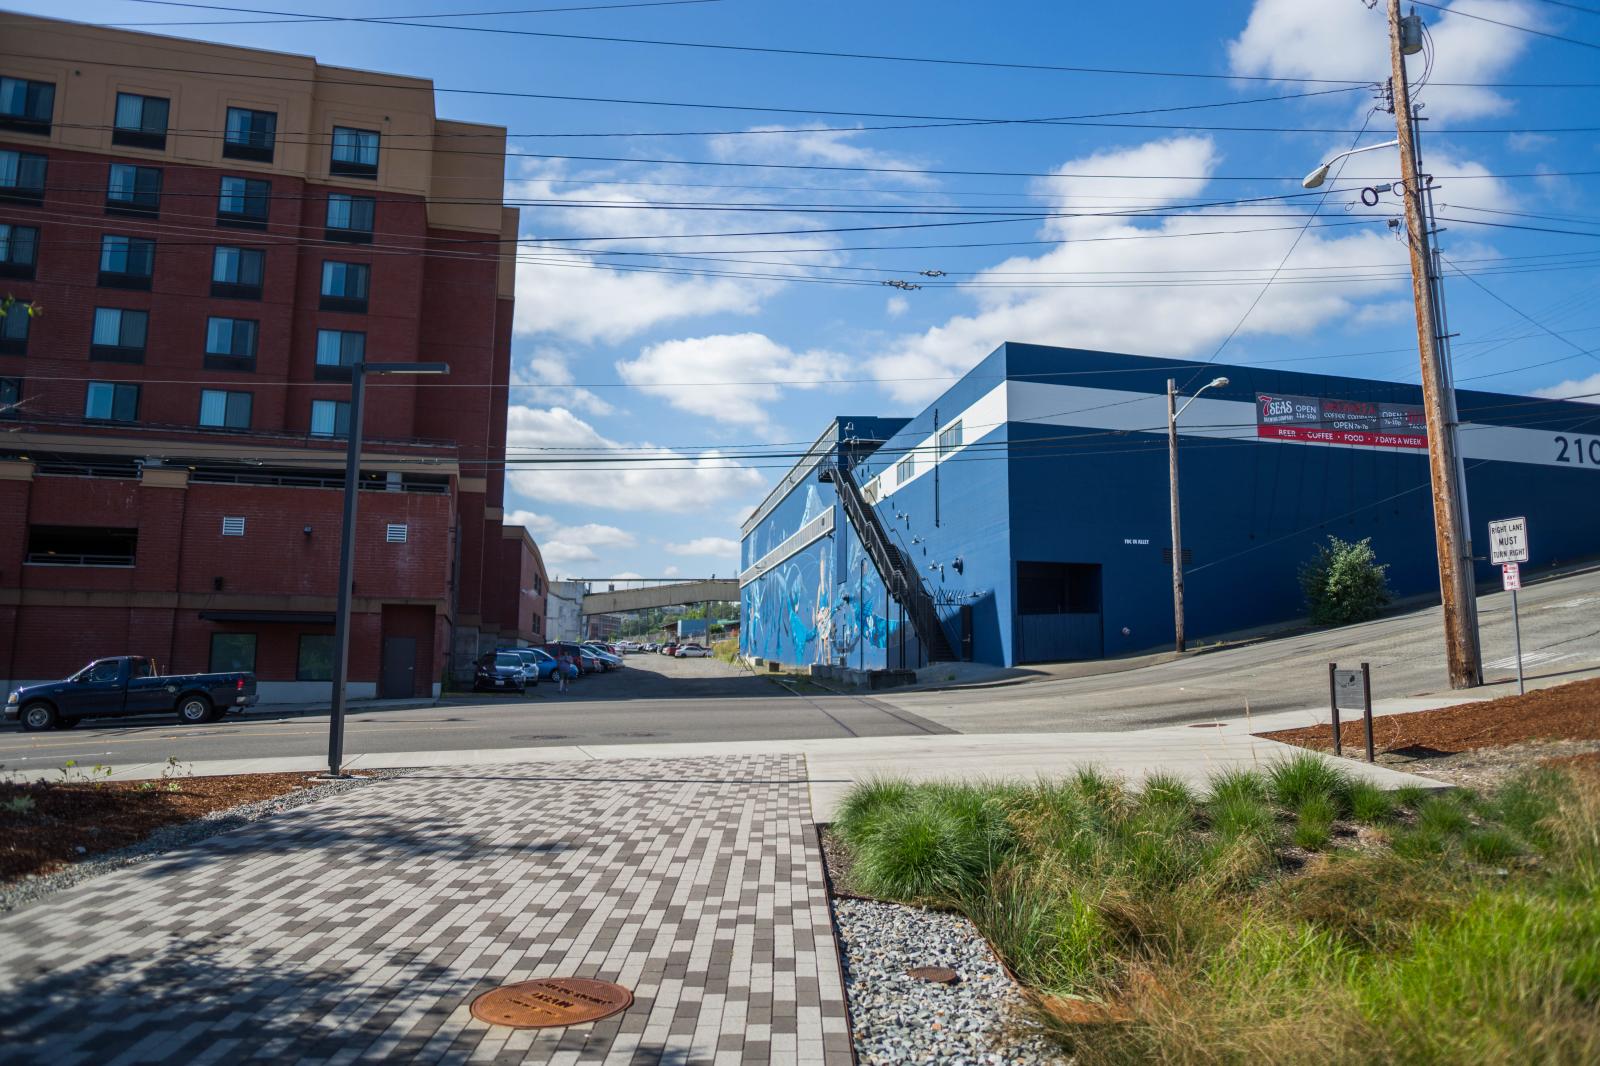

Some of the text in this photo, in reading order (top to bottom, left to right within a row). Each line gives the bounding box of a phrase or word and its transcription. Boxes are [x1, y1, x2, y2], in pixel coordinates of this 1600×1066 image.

[1258, 395, 1293, 416] 7 SEAS
[1295, 405, 1317, 413] OPEN
[1333, 421, 1354, 429] OPEN
[1306, 431, 1333, 440] COFFEE
[1344, 434, 1364, 442] FOOD
[1492, 523, 1523, 534] RIGHT LANE
[1499, 536, 1517, 545] MUST
[1493, 548, 1525, 559] TURN RIGHT
